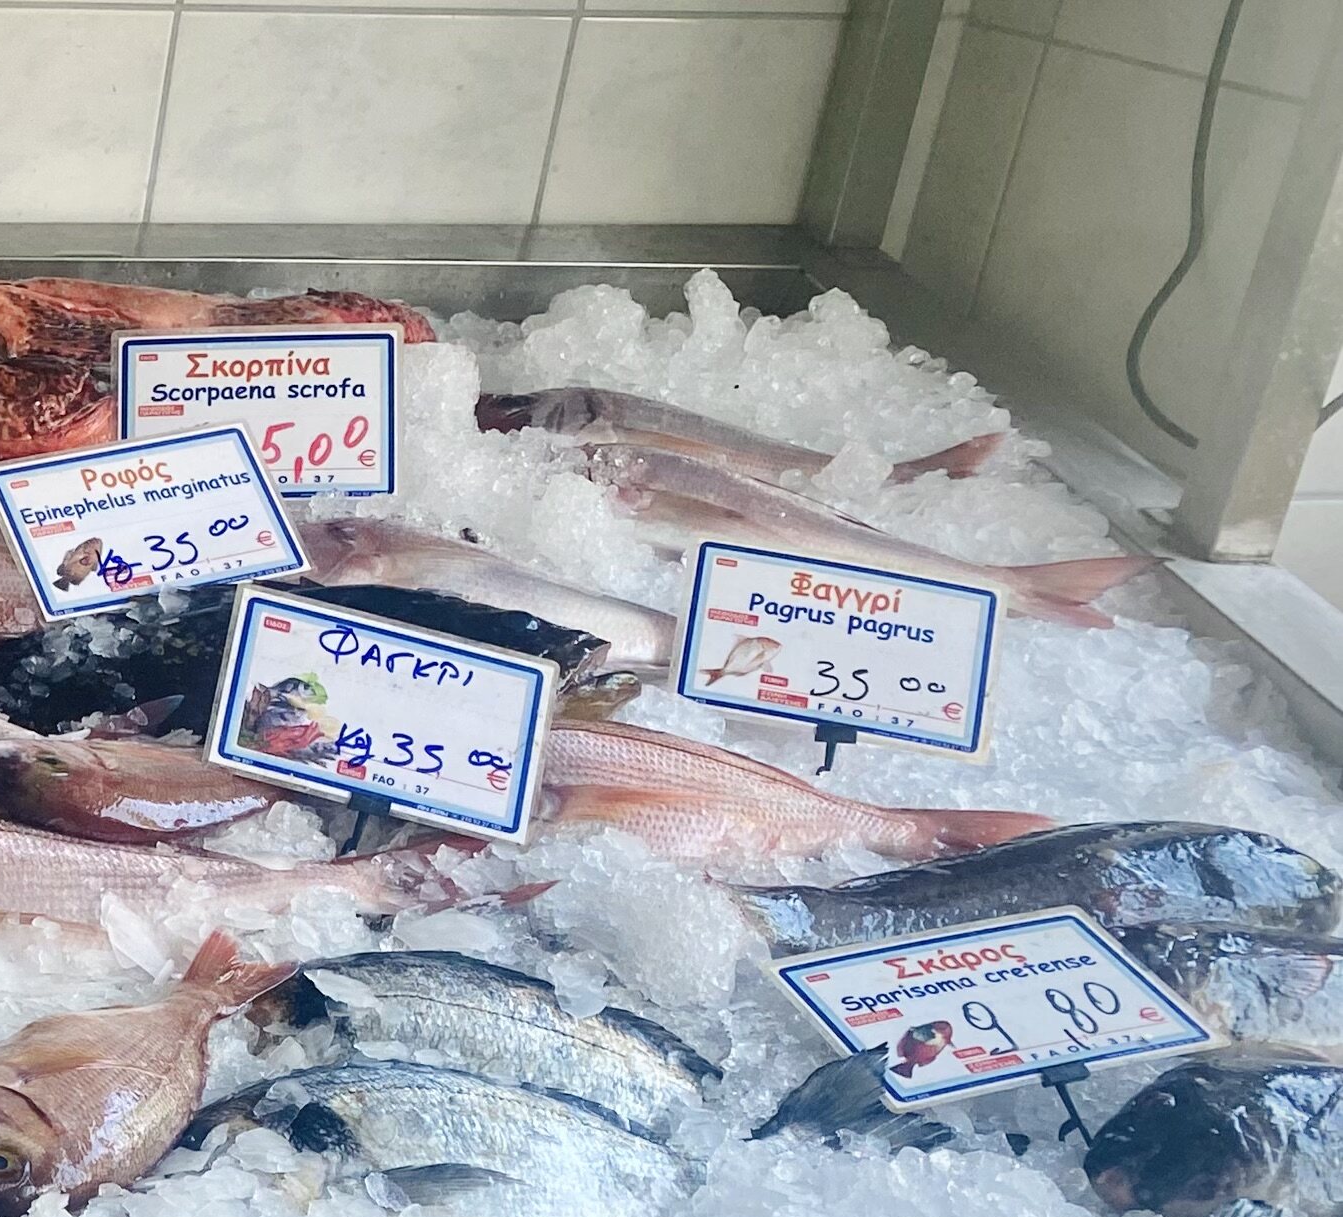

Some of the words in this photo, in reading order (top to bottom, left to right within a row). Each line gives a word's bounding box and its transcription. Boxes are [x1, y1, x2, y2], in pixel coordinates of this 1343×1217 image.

[185, 350, 331, 383] Σκορπίνα
[151, 383, 277, 406] Scorpaena
[287, 378, 366, 399] scrofa
[80, 458, 173, 492] Ροφός
[20, 493, 136, 526] Epinephelus
[144, 469, 252, 503] marginatus
[790, 571, 903, 614] Φαγγρί
[749, 592, 836, 626] Pagrus
[847, 614, 936, 643] pagrus
[810, 660, 870, 701] 35
[384, 732, 445, 774] 35
[372, 773, 396, 787] FAO
[415, 784, 430, 796] 37
[883, 942, 1028, 980] Σκάρος
[841, 976, 977, 1013] Sparisoma
[985, 952, 1097, 985] cretense
